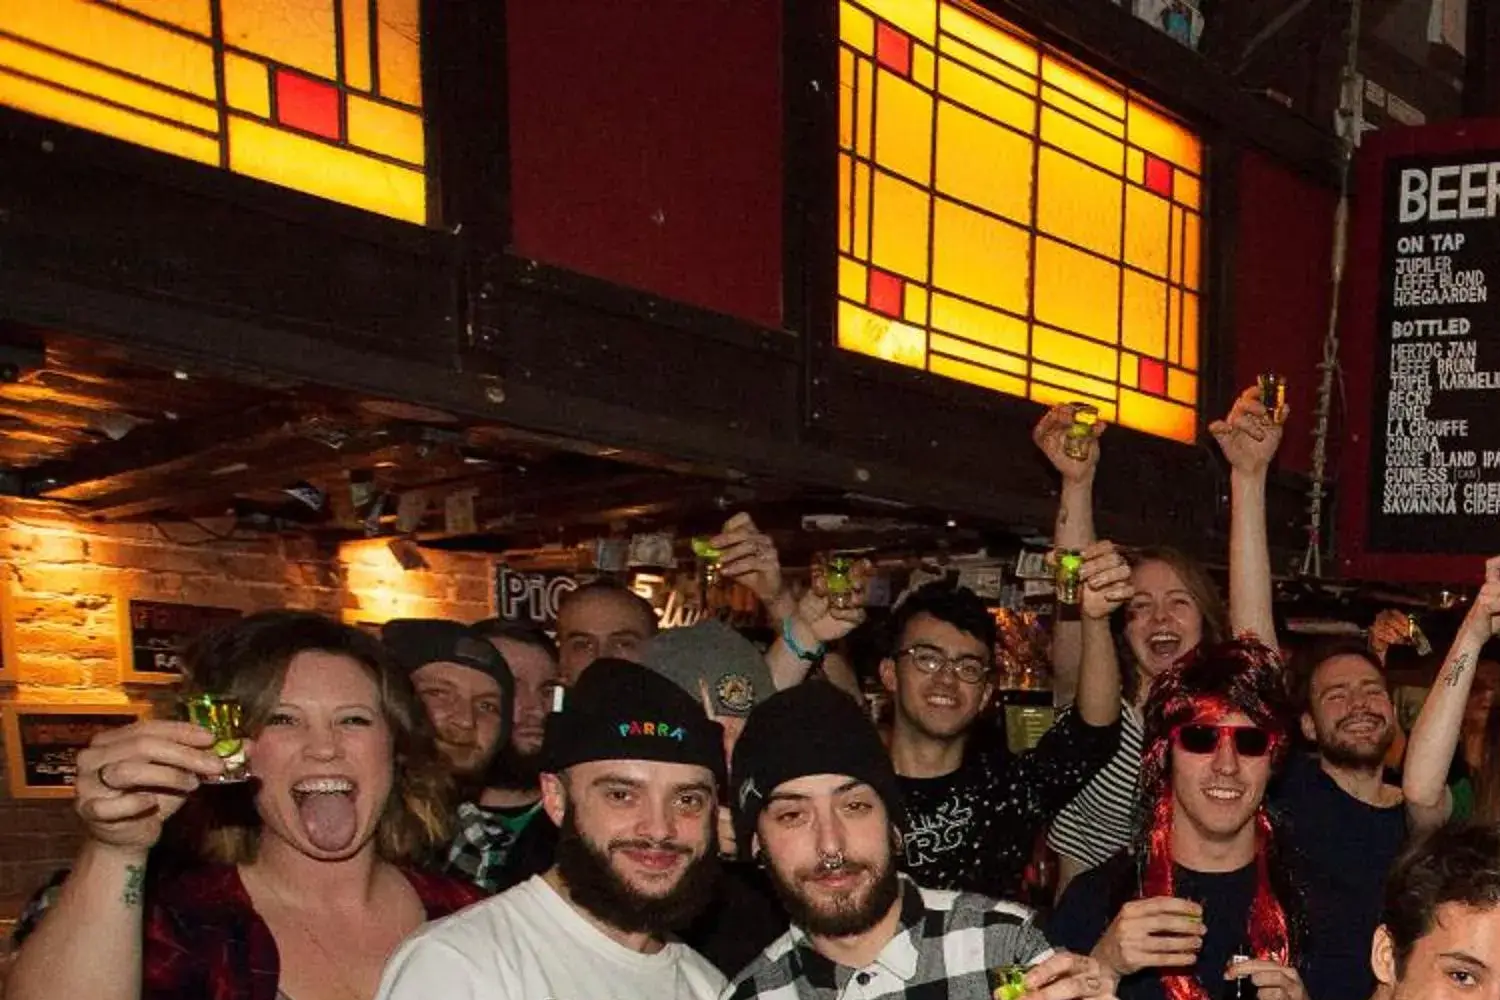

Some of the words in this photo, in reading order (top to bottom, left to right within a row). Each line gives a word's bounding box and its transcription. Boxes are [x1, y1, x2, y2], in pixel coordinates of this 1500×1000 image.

[1397, 235, 1424, 254] ON
[1431, 233, 1465, 252] TAP
[1395, 256, 1452, 275] JUPILER
[1394, 274, 1435, 291] LEFFE
[1439, 269, 1484, 288] BLOND
[1393, 286, 1487, 307] HOEGAARDEN
[1391, 318, 1471, 339] BOTTLED
[1391, 342, 1443, 361] HERTOG
[1447, 340, 1477, 359] JAN
[1390, 359, 1431, 375] LEFFE
[1388, 390, 1432, 406] BECKS
[1386, 421, 1404, 437] LA
[1409, 419, 1469, 437] CHOUFFE
[1386, 436, 1439, 452] CORONA
[1385, 452, 1425, 467] GOOSE
[1430, 451, 1477, 468] ISLAND
[1385, 467, 1448, 483] GUINESS
[1384, 483, 1457, 499] SOMERSBY
[1382, 498, 1457, 514] SAVANNA
[618, 720, 686, 742] PARRA
